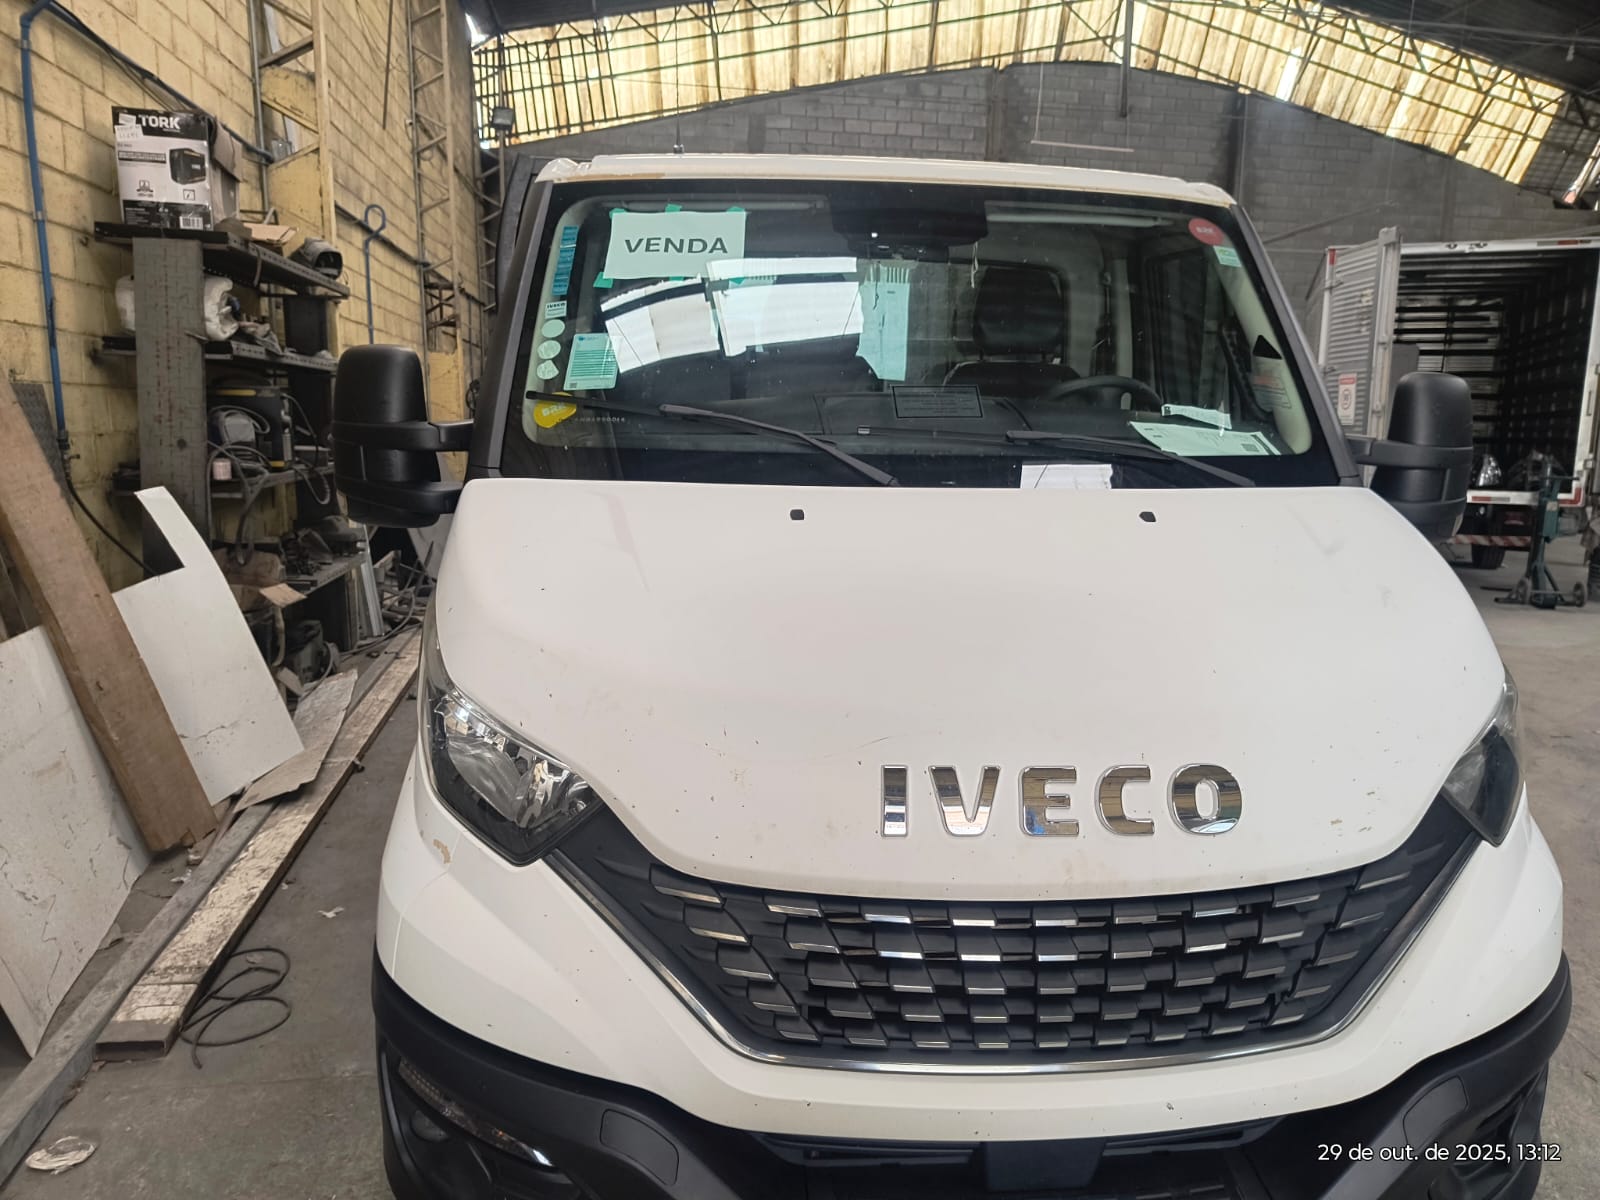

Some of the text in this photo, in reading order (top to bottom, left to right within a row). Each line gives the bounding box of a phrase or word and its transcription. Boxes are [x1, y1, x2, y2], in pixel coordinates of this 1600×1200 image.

[139, 115, 181, 129] TORK
[625, 237, 728, 253] VENDA
[881, 763, 1243, 837] IVECO
